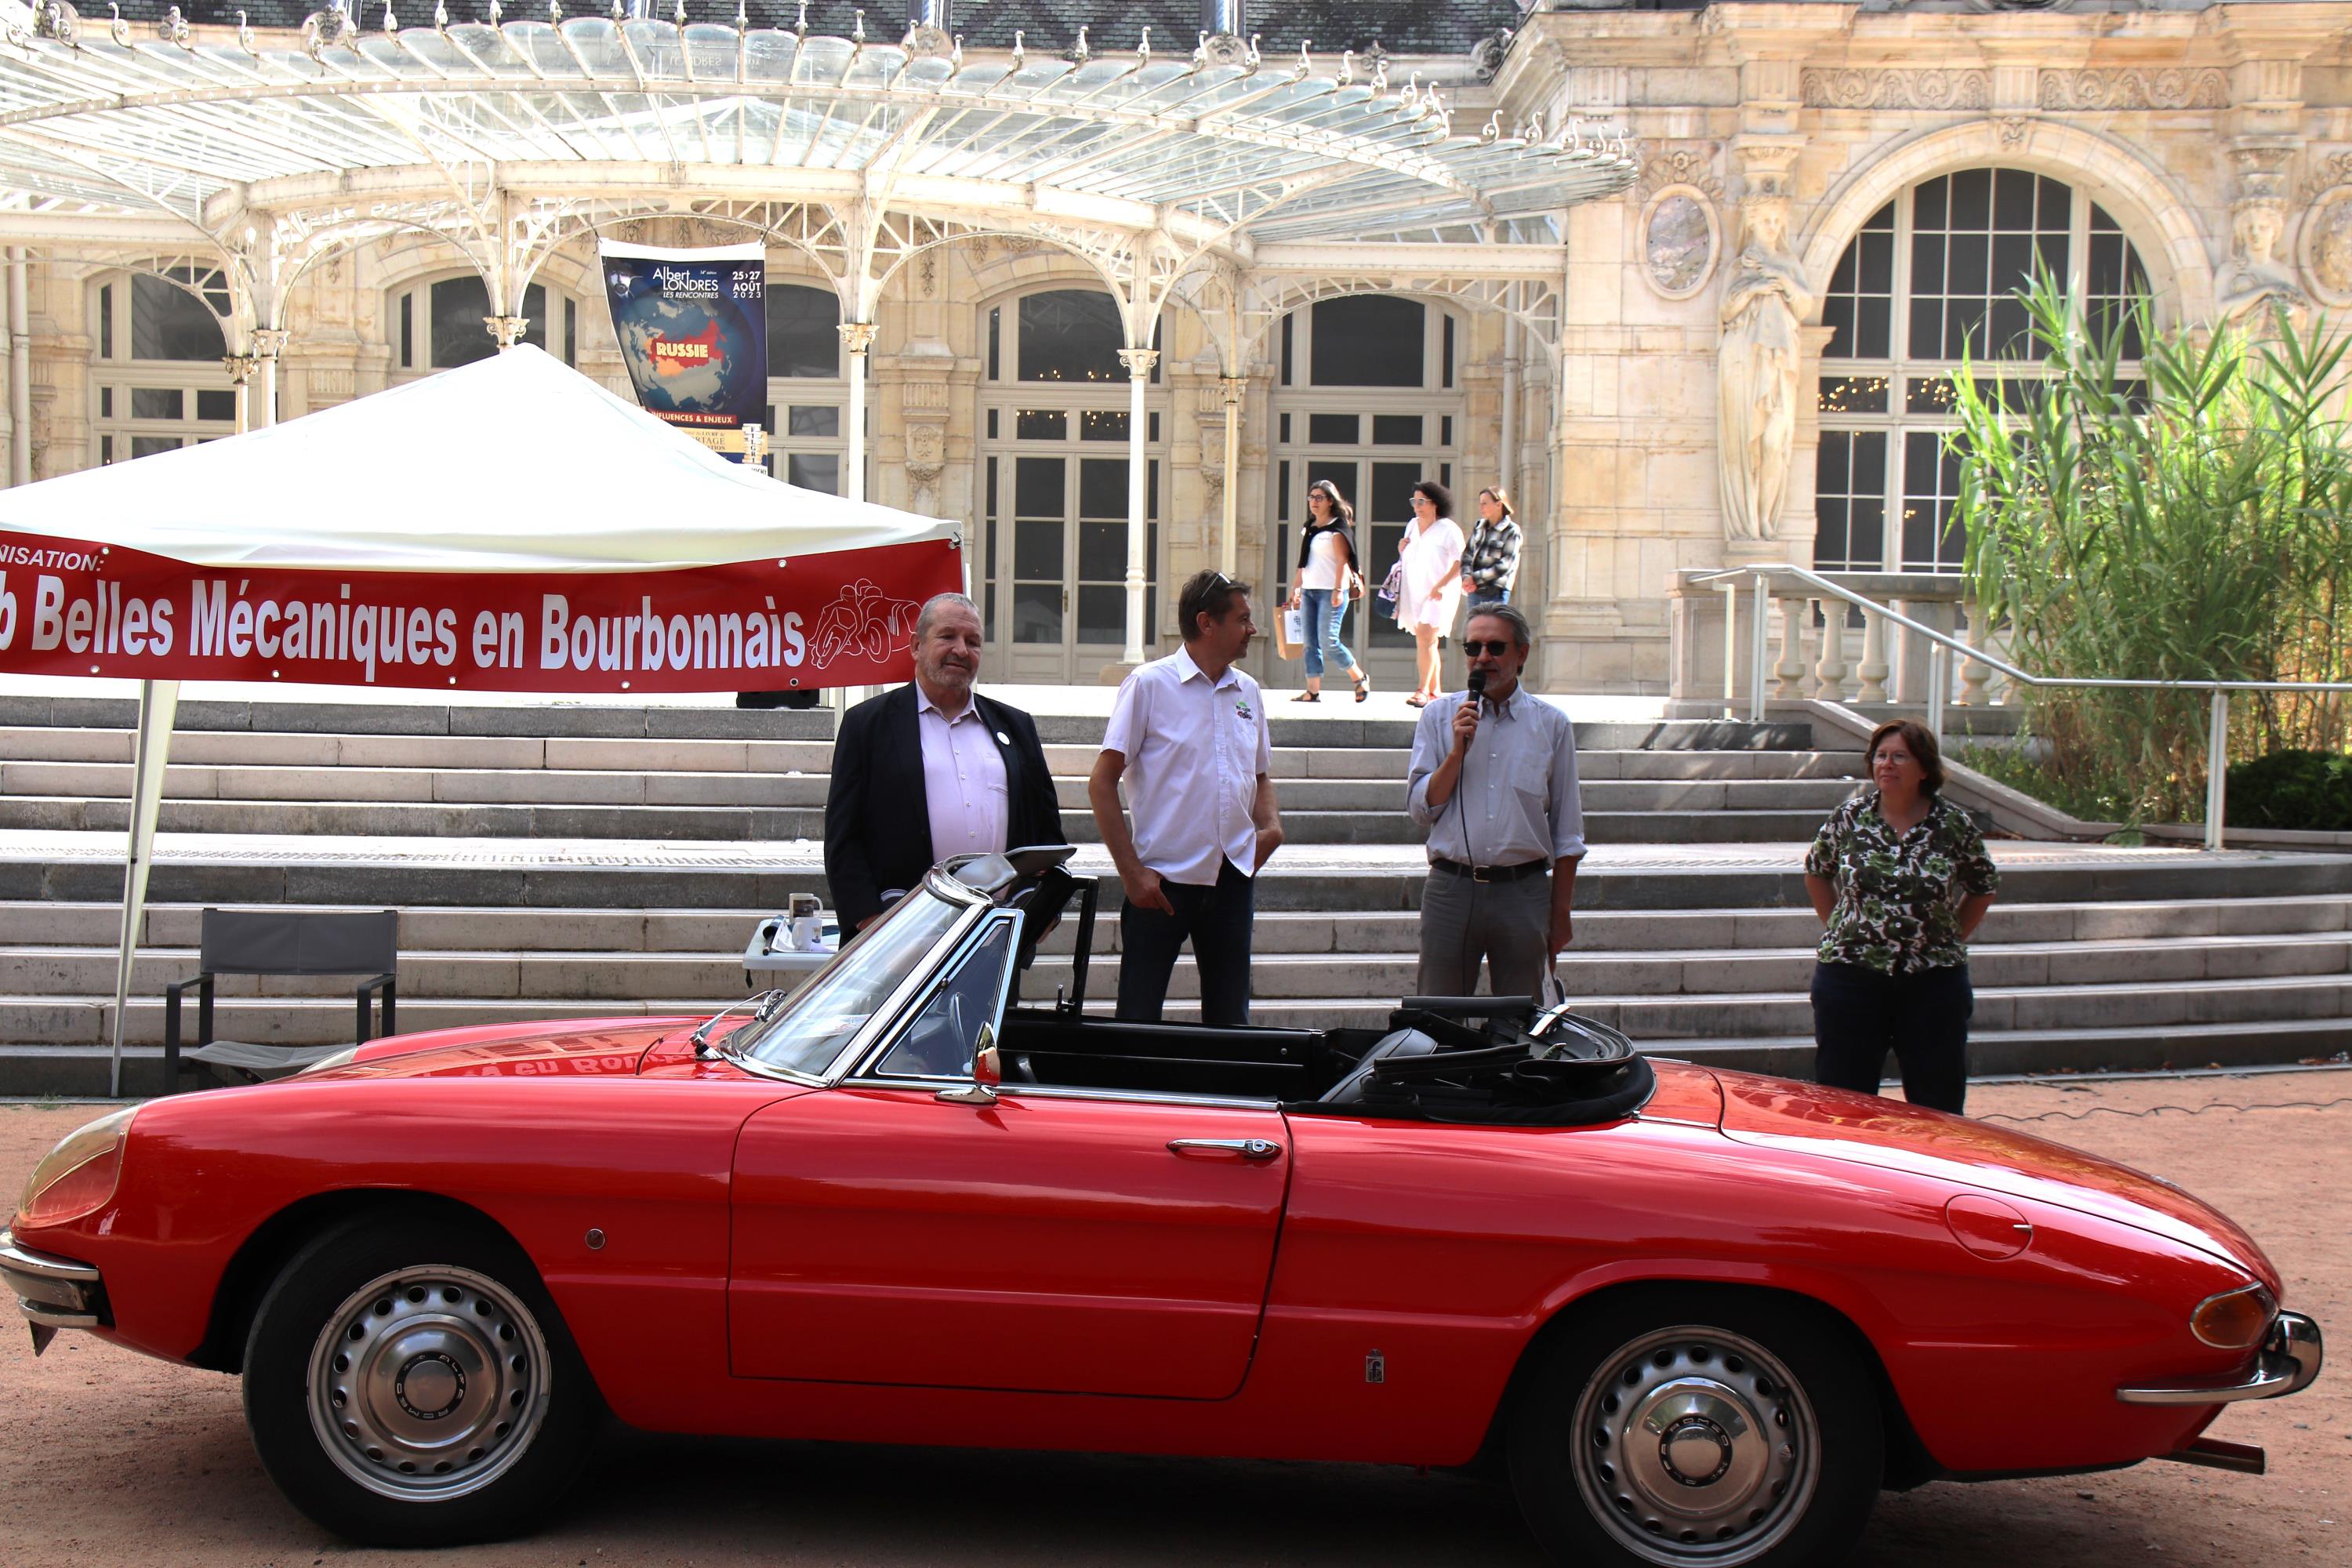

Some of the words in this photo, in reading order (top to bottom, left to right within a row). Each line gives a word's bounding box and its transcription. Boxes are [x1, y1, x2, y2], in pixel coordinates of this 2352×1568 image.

[652, 267, 690, 281] Albert
[662, 278, 719, 291] LONDRES
[732, 281, 761, 292] AOÛT
[656, 342, 709, 358] RUSSIE
[704, 416, 733, 424] ENJEUX
[31, 574, 174, 656] Belles
[190, 579, 457, 683] Mécaniques
[473, 610, 524, 669] en
[540, 593, 806, 672] Bourbonnais
